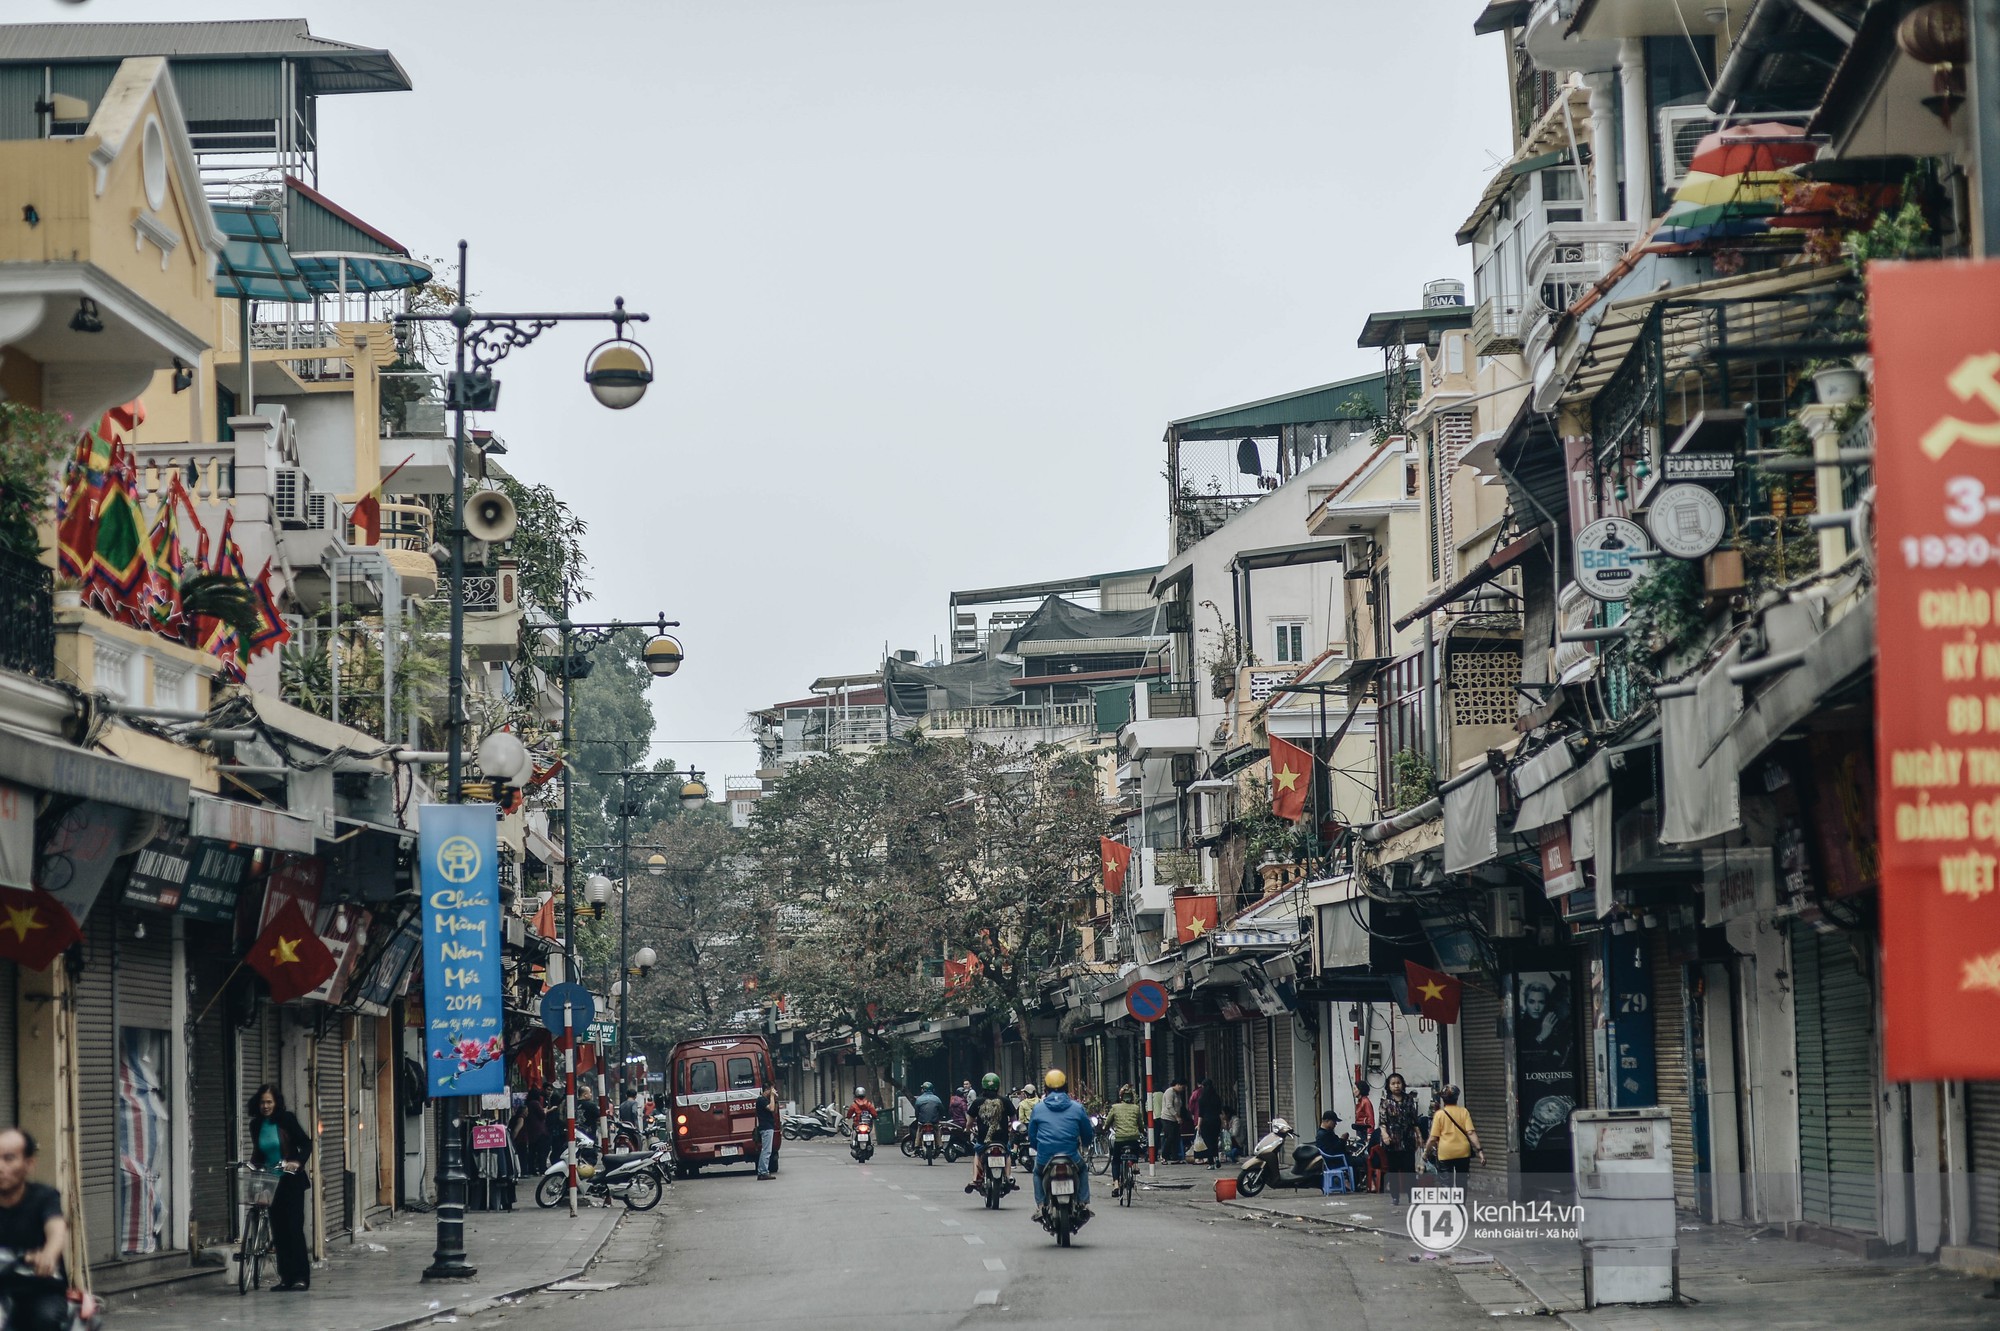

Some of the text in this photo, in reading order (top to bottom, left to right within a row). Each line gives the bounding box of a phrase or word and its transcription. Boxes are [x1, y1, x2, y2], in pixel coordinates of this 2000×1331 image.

[1667, 459, 1734, 471] FURBREW
[1690, 490, 1717, 510] STREET
[1666, 538, 1703, 551] BREWING
[1919, 580, 1991, 629] CHÀO
[1947, 695, 1983, 734] 89
[1892, 740, 1963, 788] NGÀY
[1896, 790, 1970, 841] ĐẢNG
[1940, 848, 1998, 900] VIỆT
[430, 889, 489, 909] Chúc
[435, 914, 486, 947] Mừng
[441, 941, 483, 962] Năm
[445, 967, 480, 989] Mới
[445, 994, 482, 1011] 2019
[1620, 993, 1647, 1013] 79
[602, 1024, 614, 1033] WC
[1525, 1071, 1573, 1080] LONGINES
